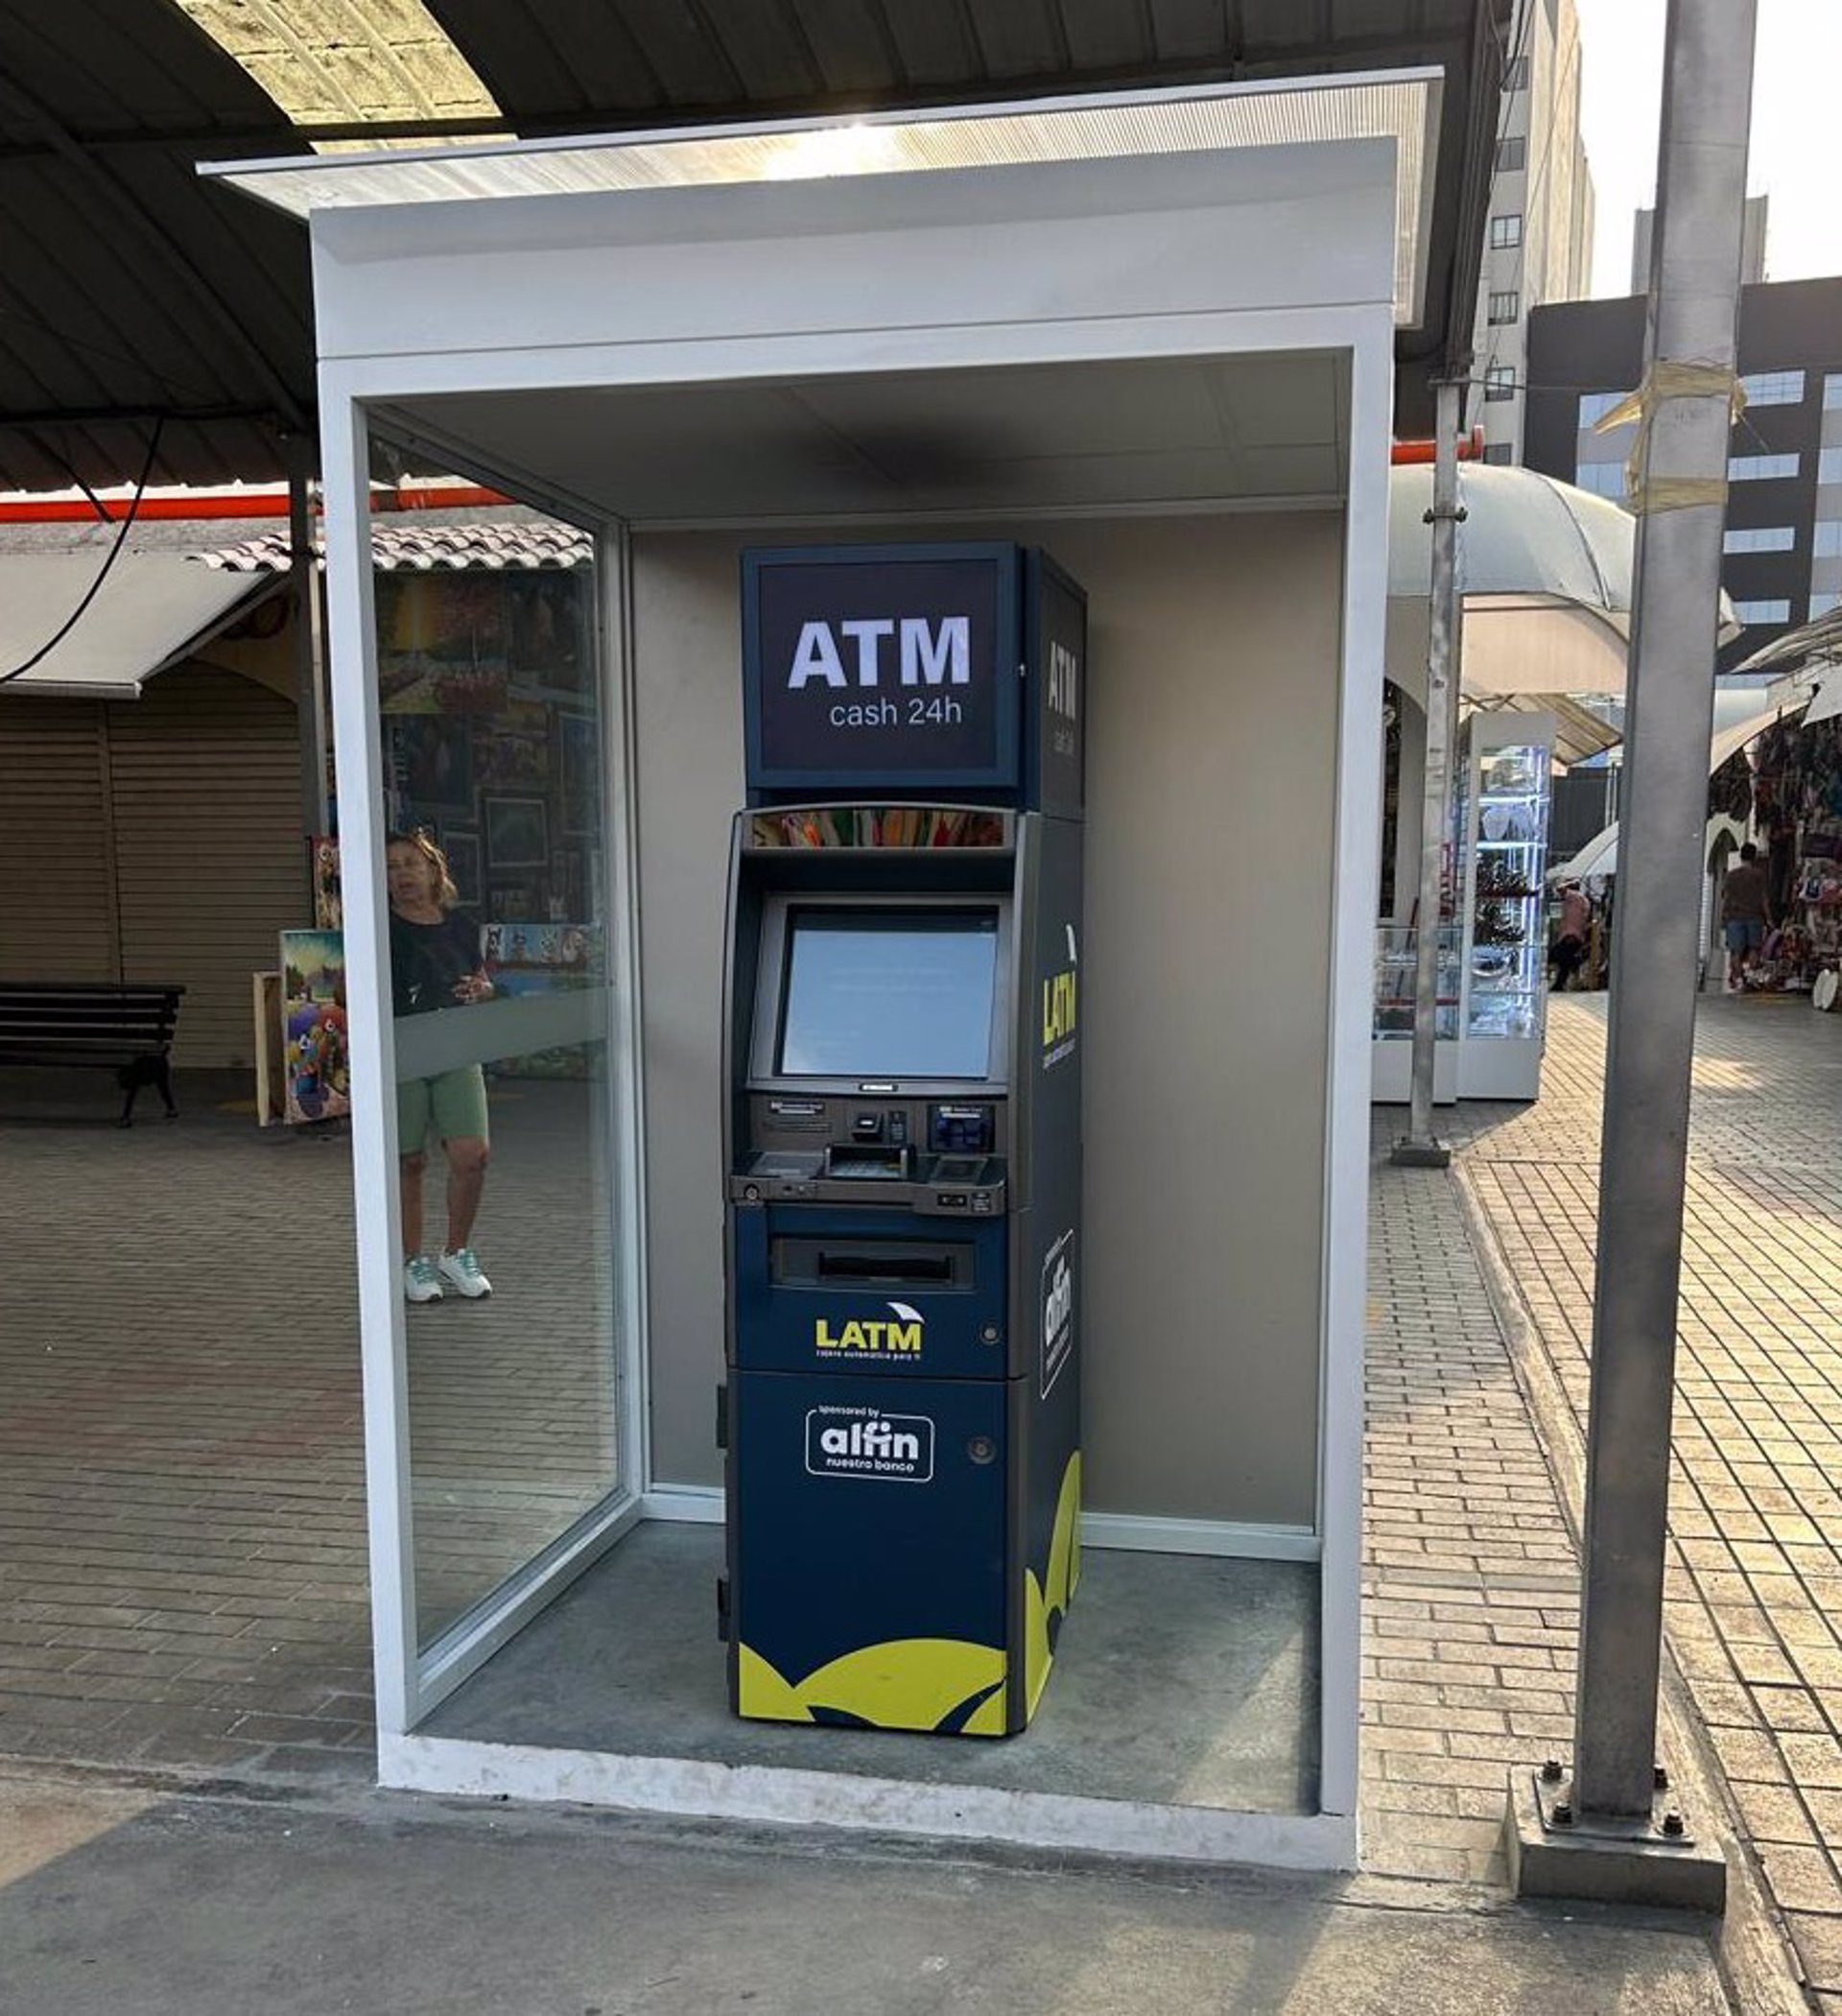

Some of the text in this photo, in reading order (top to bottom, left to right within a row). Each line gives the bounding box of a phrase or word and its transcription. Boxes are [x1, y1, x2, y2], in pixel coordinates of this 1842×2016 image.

[788, 616, 970, 688] ATM
[1048, 640, 1075, 722] ATM
[830, 696, 961, 725] cash 24h
[816, 1319, 921, 1351] LATM
[818, 1405, 880, 1419] sponsored by
[820, 1421, 919, 1459] alfin
[826, 1458, 914, 1473] nuestro banco
